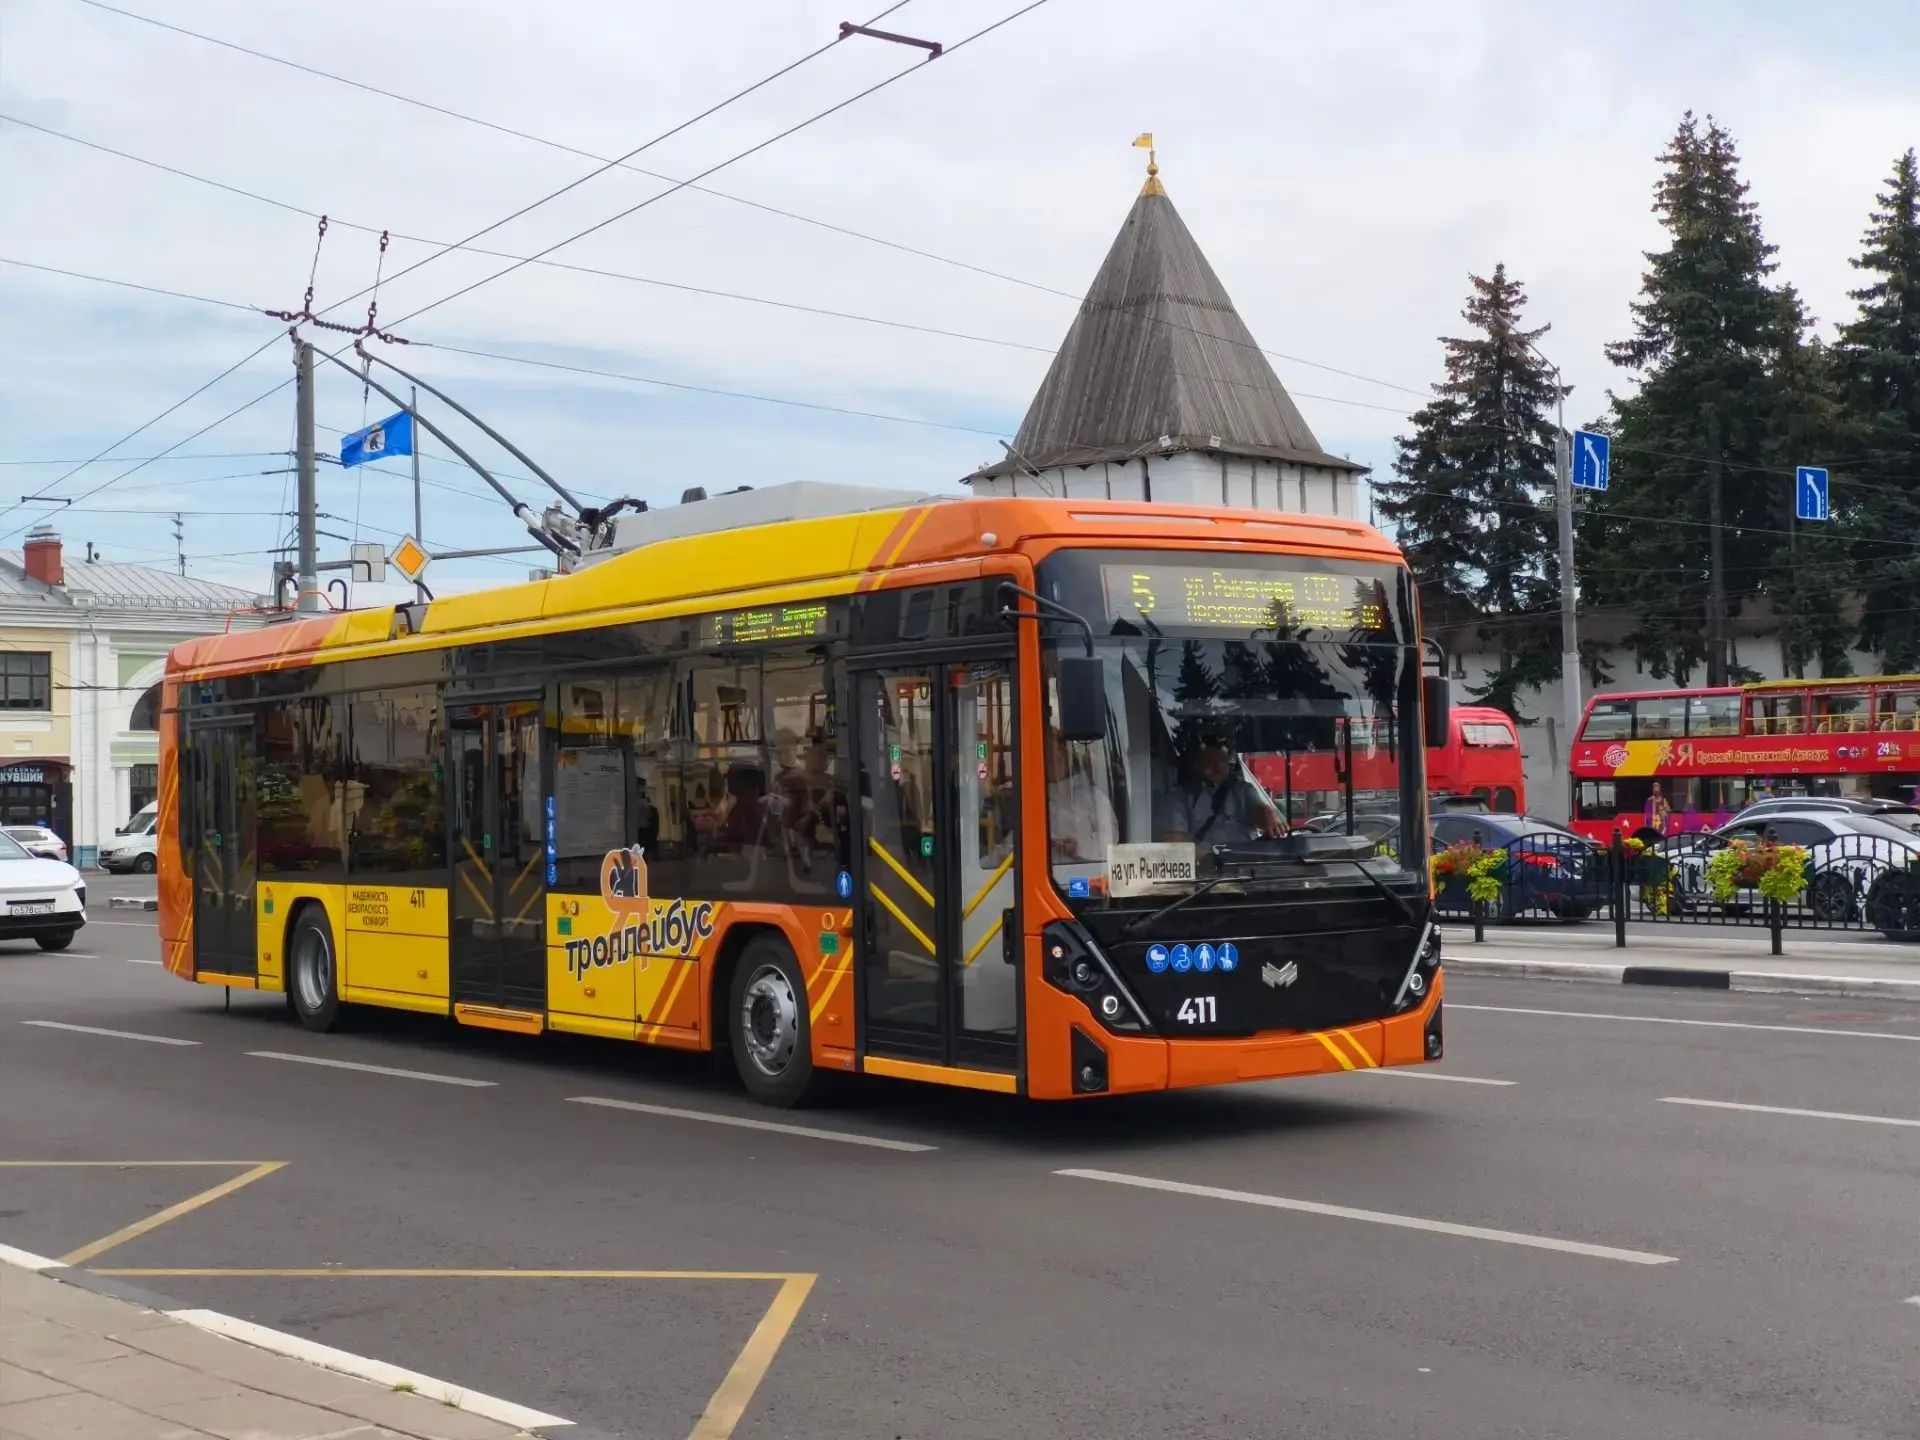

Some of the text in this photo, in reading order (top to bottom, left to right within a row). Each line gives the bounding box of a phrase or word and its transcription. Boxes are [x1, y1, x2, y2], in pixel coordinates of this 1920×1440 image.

[1131, 573, 1155, 614] 5
[0, 772, 43, 783] КУВШИН
[1111, 857, 1192, 885] на ул. Рыкачева
[348, 903, 389, 915] БЕЗОПАСНОСТЬ
[410, 889, 425, 909] 411
[362, 916, 389, 927] КОМФОРТ
[565, 898, 714, 982] троллейбус
[1177, 996, 1217, 1025] 411
